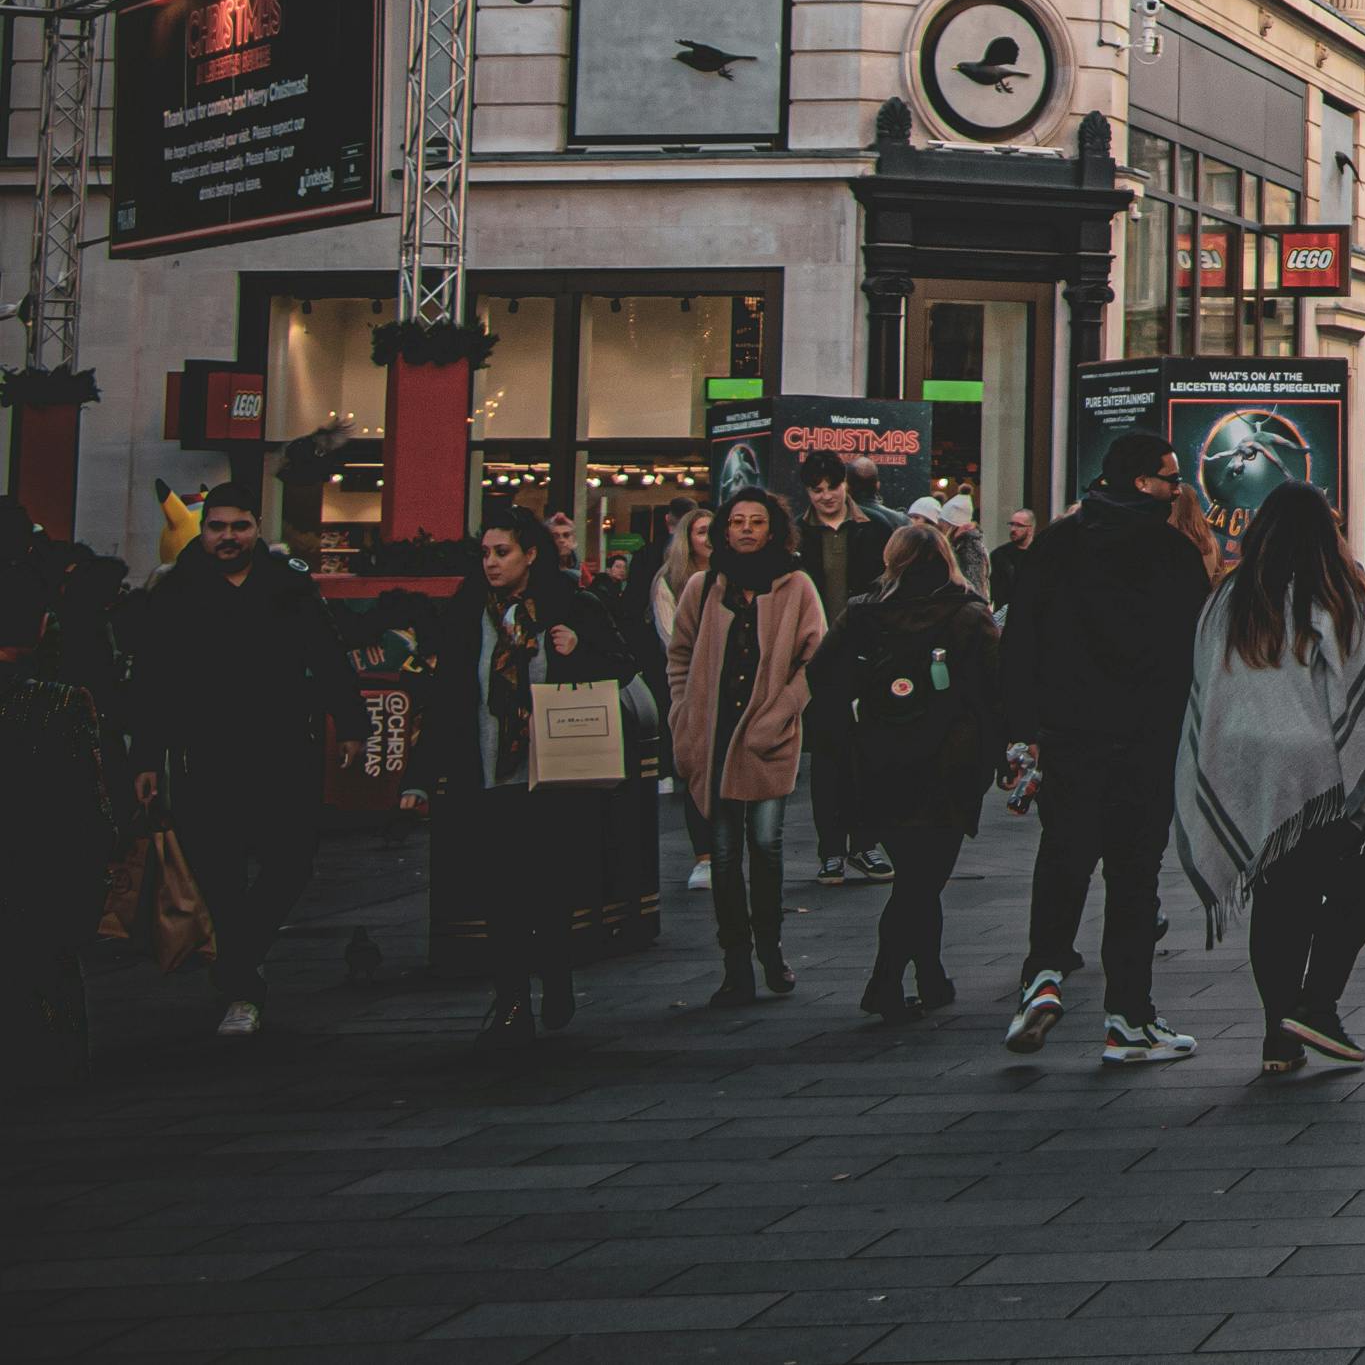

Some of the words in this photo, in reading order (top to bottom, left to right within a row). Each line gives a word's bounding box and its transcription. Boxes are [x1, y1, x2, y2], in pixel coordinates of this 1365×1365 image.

[1286, 250, 1334, 270] LEGO
[1210, 371, 1249, 382] WHAT'S
[1250, 372, 1266, 382] ON
[1268, 372, 1281, 382] AT
[1283, 372, 1303, 382] THE
[1170, 383, 1226, 392] LEICESTER
[1228, 383, 1271, 393] SQUARE
[1273, 383, 1341, 393] SPIEGELTENT
[232, 394, 262, 417] LEGO
[1085, 397, 1101, 408] PURE
[1103, 392, 1155, 407] ENTERTAINMENT
[831, 415, 868, 425] Welcome
[871, 417, 880, 425] to
[783, 426, 920, 453] CHRISTMAS
[386, 692, 409, 771] @CHRIS
